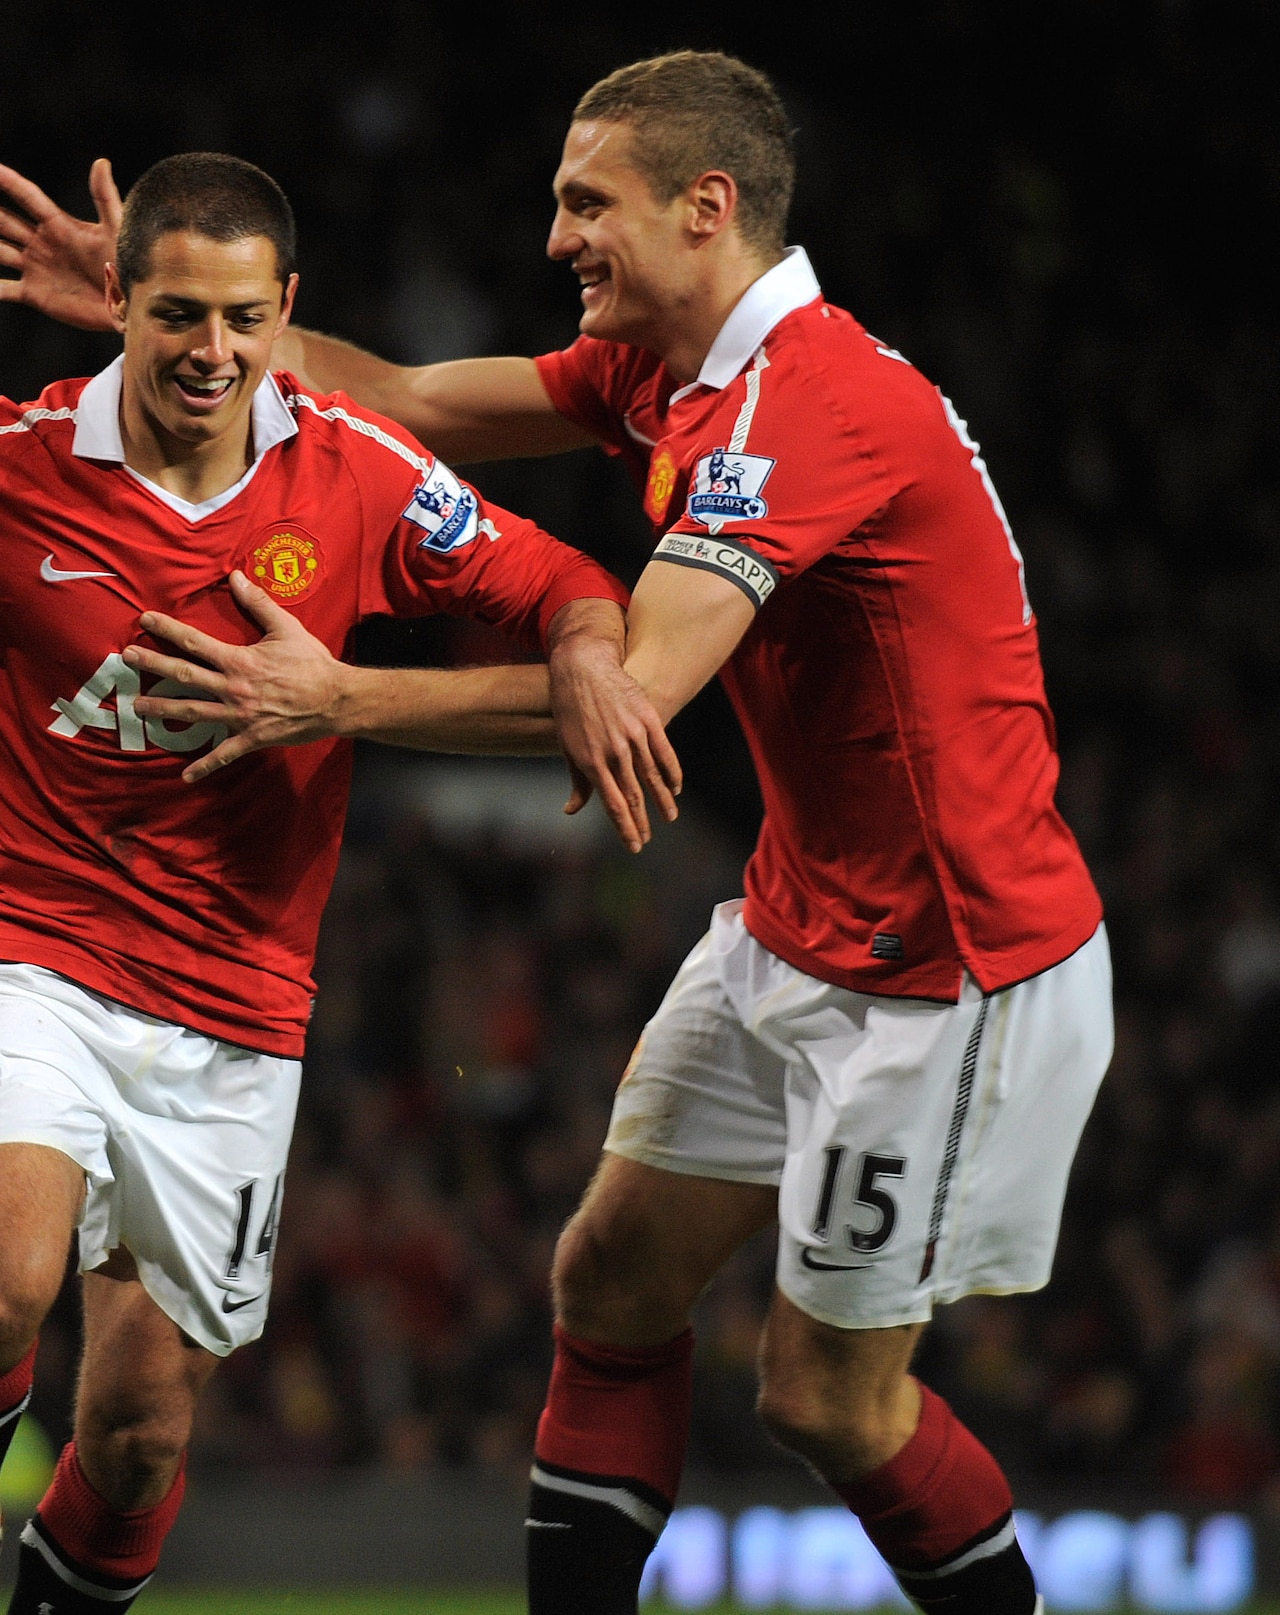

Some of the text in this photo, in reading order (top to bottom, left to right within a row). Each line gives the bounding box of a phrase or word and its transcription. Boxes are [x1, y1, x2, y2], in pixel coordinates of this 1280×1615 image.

[694, 495, 743, 509] BARCLAYS
[259, 538, 310, 561] MANCHESTER
[270, 578, 307, 593] UNITED
[809, 1145, 909, 1254] 15
